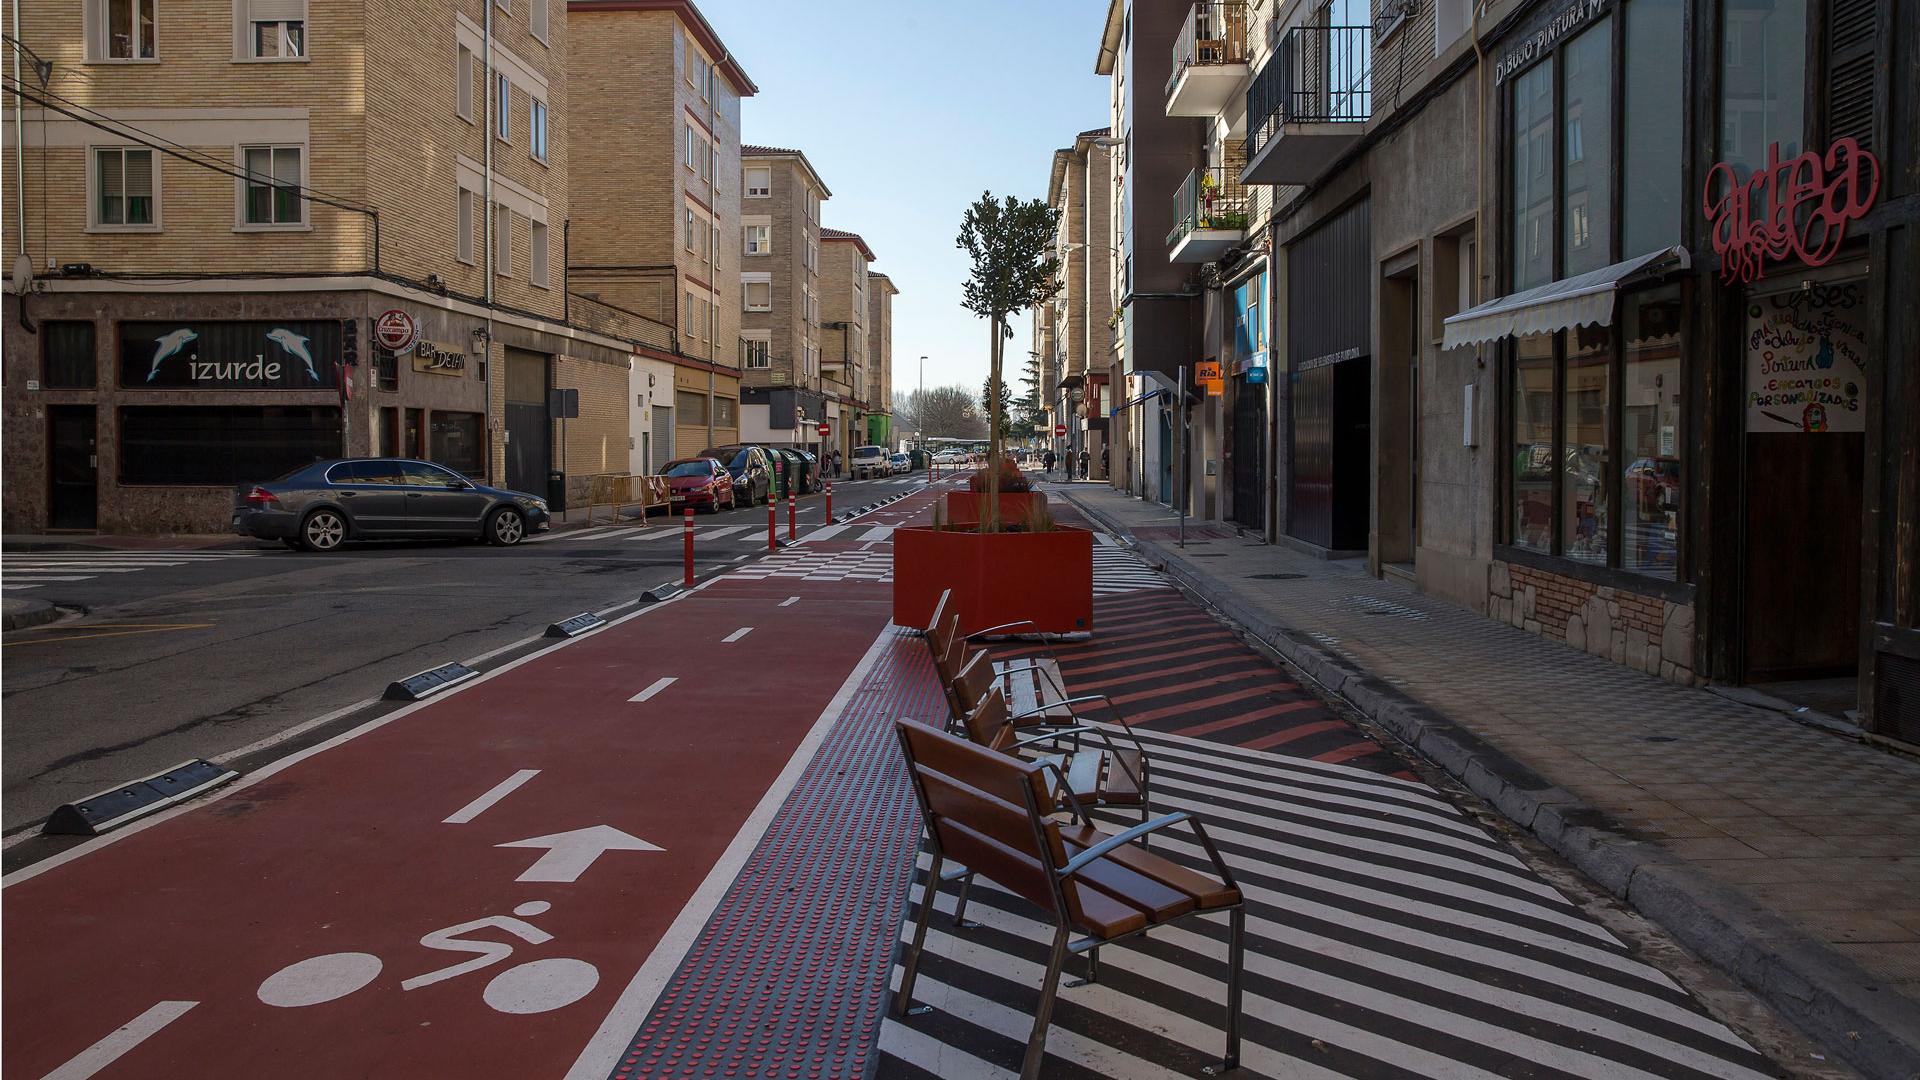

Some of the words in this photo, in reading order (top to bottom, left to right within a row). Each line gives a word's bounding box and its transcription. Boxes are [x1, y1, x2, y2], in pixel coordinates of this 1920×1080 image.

[1536, 1, 1584, 57] PINTURA
[420, 342, 436, 358] BAR
[189, 354, 281, 380] izurde
[1200, 367, 1217, 378] Ria
